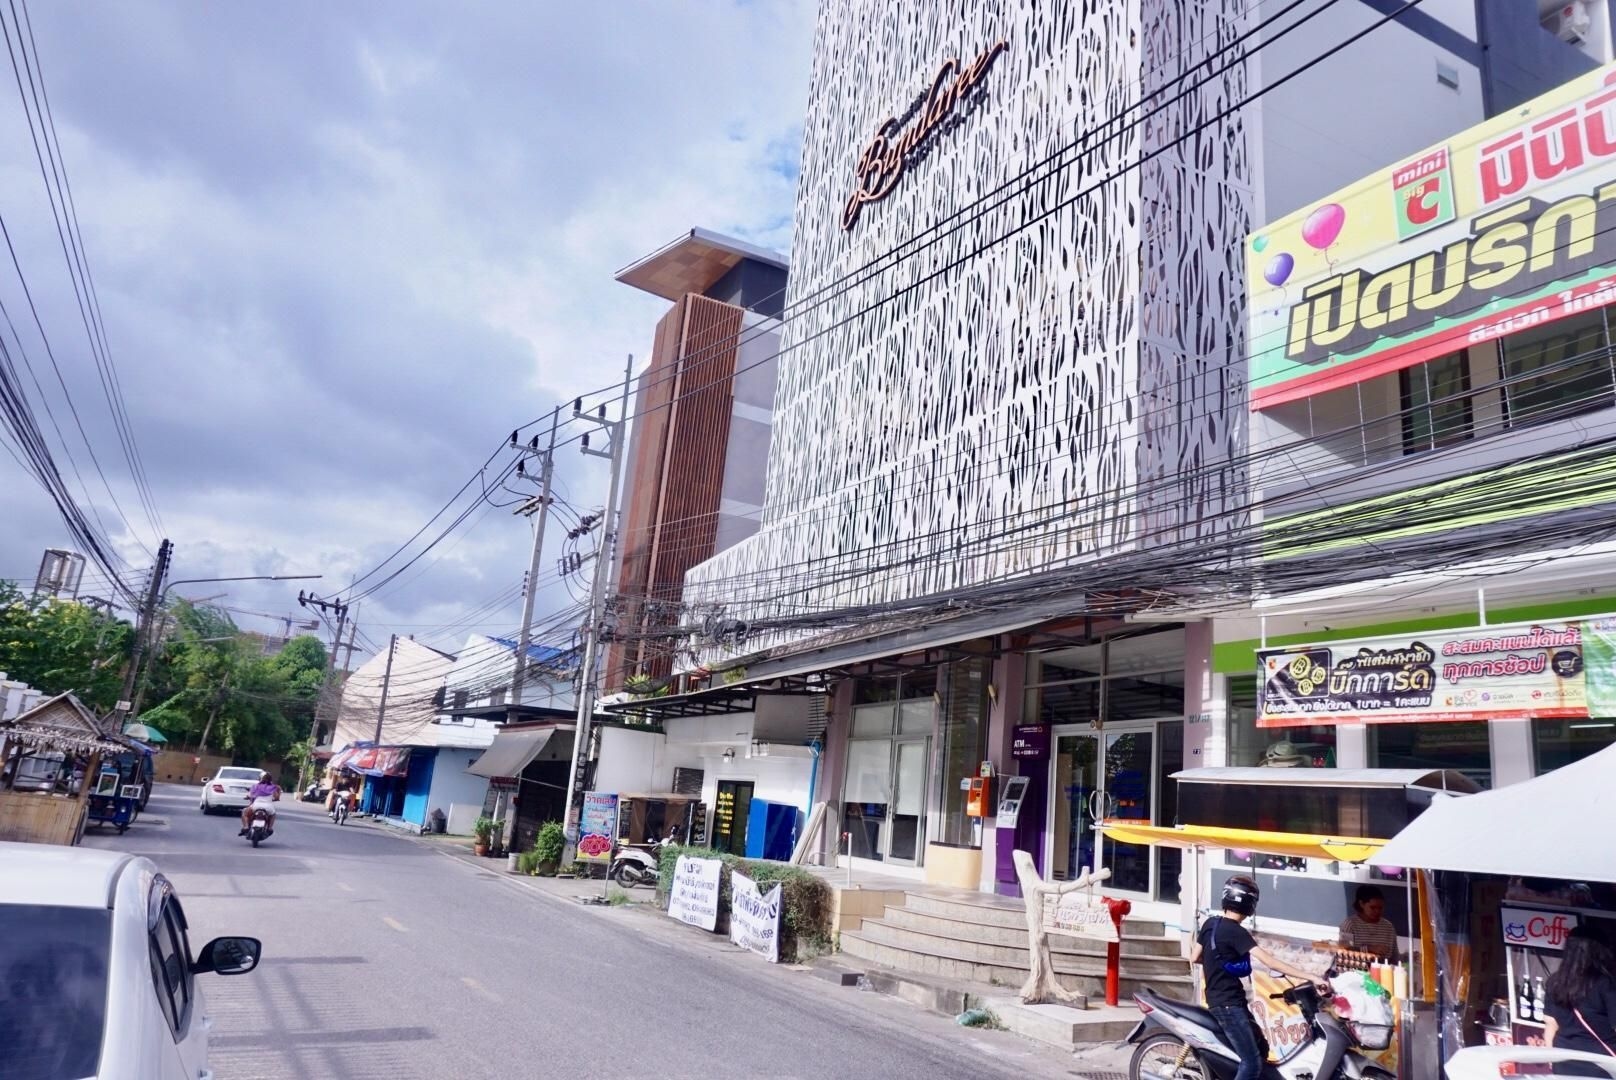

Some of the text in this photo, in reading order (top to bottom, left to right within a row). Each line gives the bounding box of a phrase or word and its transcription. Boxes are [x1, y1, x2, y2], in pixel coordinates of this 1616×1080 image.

[1397, 152, 1442, 186] mini
[1288, 182, 1616, 357] เปิดบริก
[1013, 739, 1025, 748] ATM
